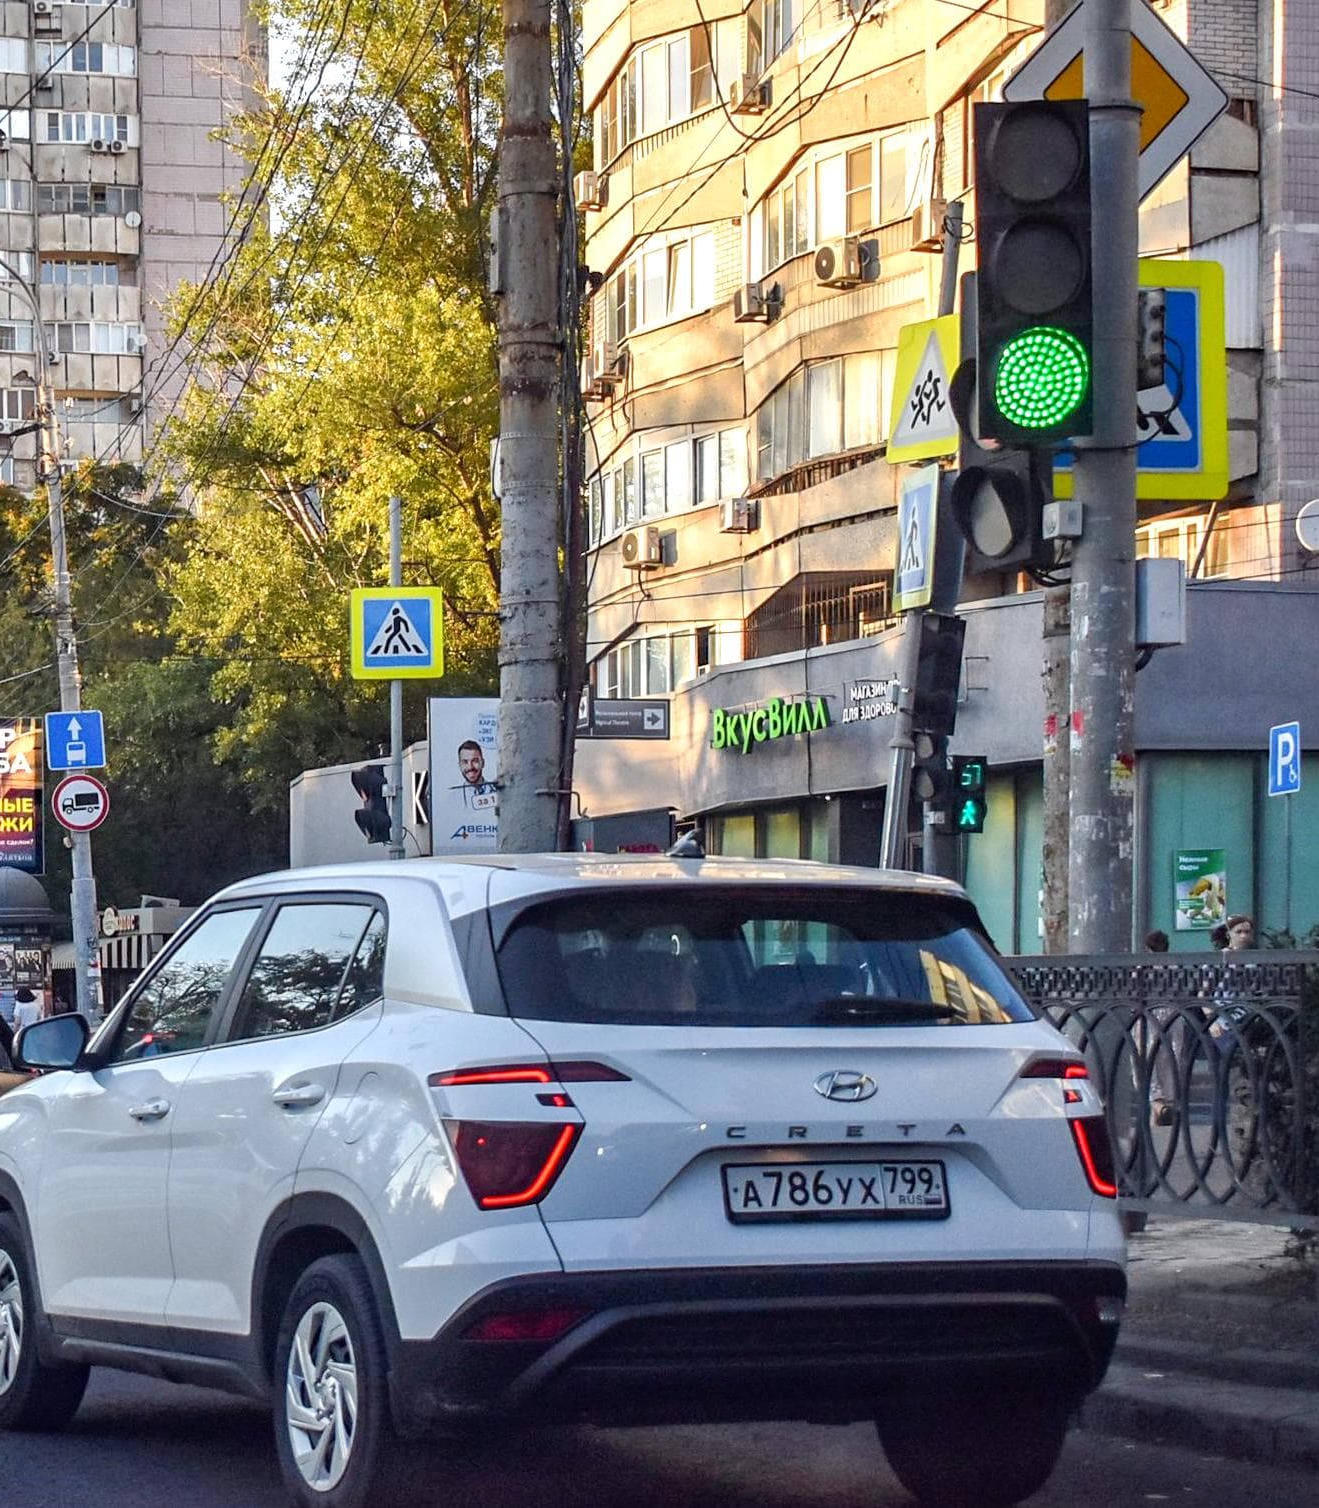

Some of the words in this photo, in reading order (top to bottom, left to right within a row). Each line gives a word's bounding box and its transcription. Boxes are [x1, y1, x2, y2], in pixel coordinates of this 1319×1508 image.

[850, 681, 887, 701] МАГАЗИН
[842, 707, 859, 724] ДЛЯ
[726, 1123, 967, 1139] CRETA
[742, 1170, 881, 1208] А786УХ
[884, 1166, 934, 1194] 799
[898, 1194, 924, 1204] RUS
